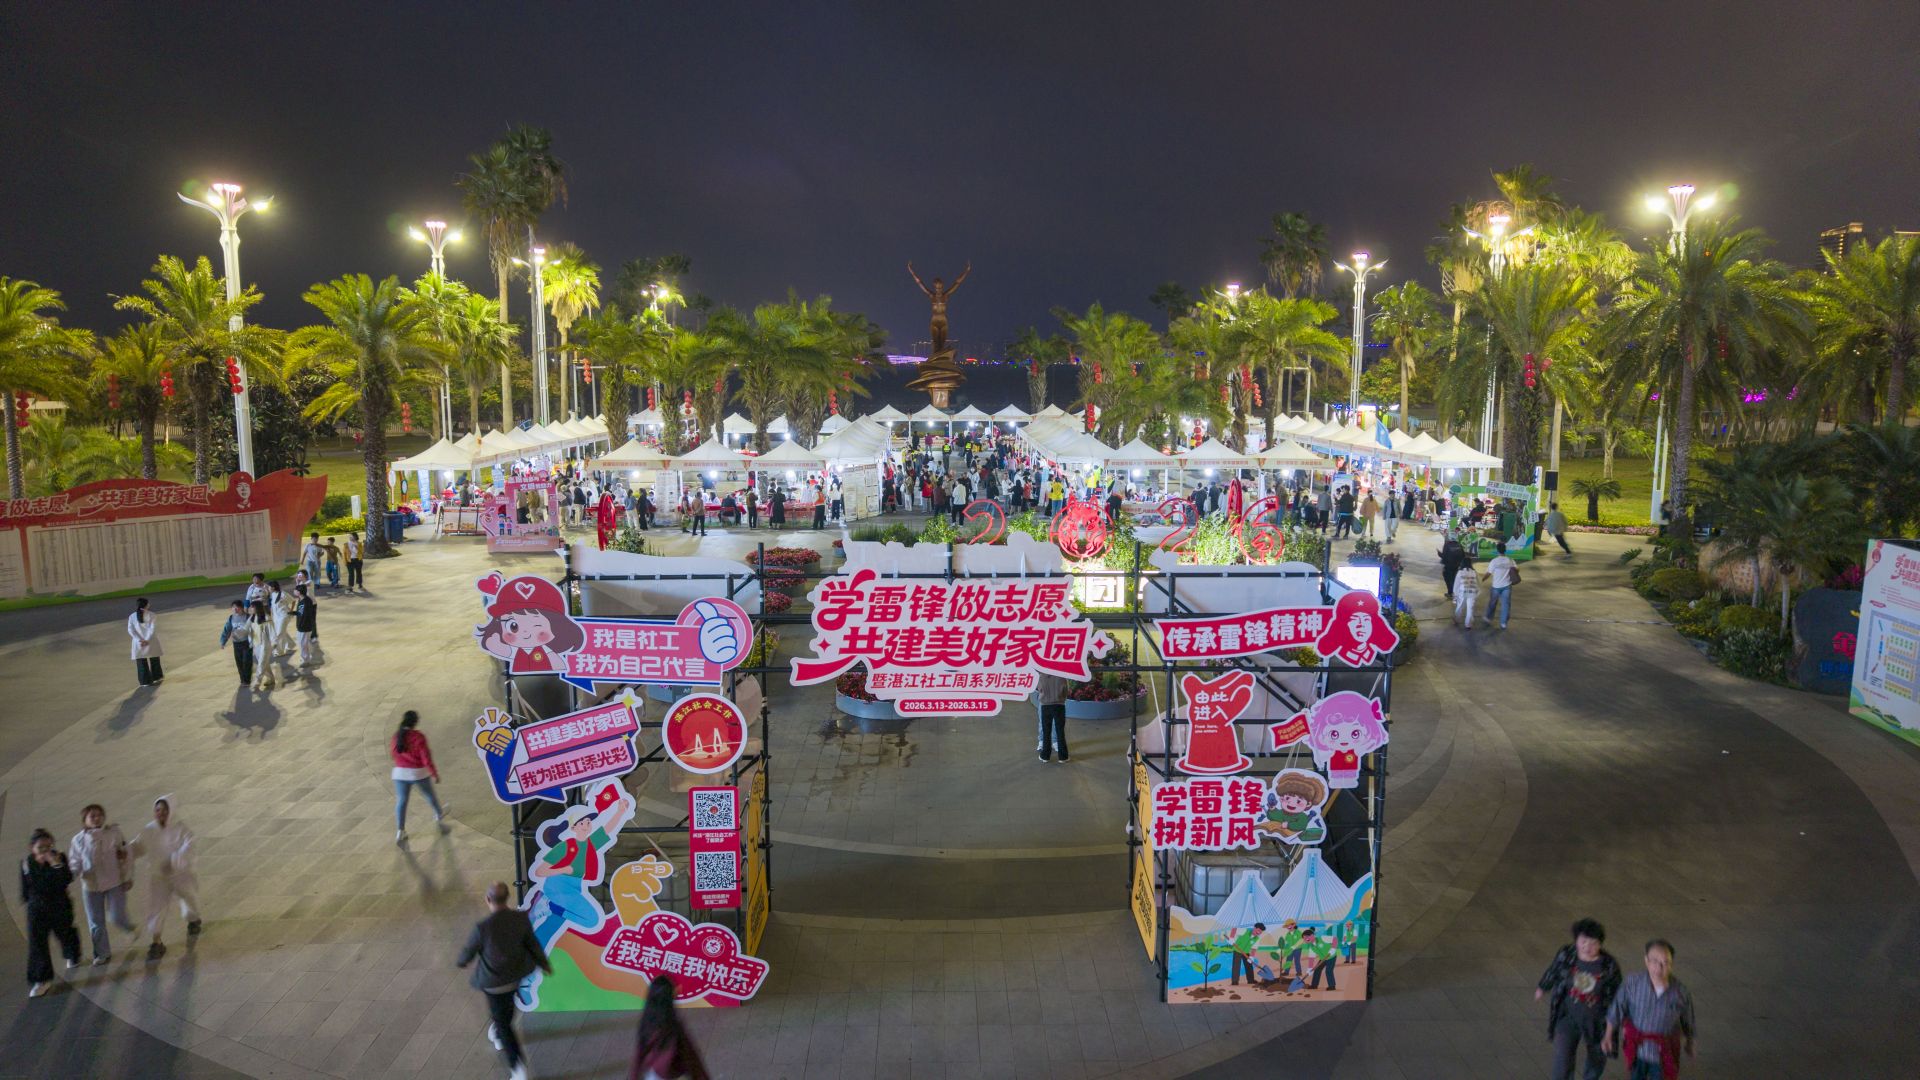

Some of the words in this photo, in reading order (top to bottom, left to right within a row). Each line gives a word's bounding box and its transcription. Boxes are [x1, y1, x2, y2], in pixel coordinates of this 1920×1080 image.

[78, 484, 210, 516] 共建美好家园
[816, 569, 1069, 630] 学雷锋做志愿
[593, 628, 680, 651] 我是社工
[1166, 610, 1323, 653] 传承雷锋精神
[575, 653, 705, 678] 我为自己代言
[796, 625, 1090, 680] 共建美好家园
[870, 672, 1034, 689] 暨湛江社工周系列活动
[674, 700, 733, 723] 湛江社会工作
[903, 701, 989, 710] 2026.3.13-2026.3.15
[1193, 705, 1229, 721] 进入
[1194, 690, 1229, 704] 由此
[526, 706, 632, 752] 共建美好家园
[520, 746, 630, 789] 我为湛江添光彩
[1155, 780, 1264, 816] 学雷锋
[1154, 816, 1257, 848] 树新风
[617, 939, 751, 992] 我志愿我快乐
